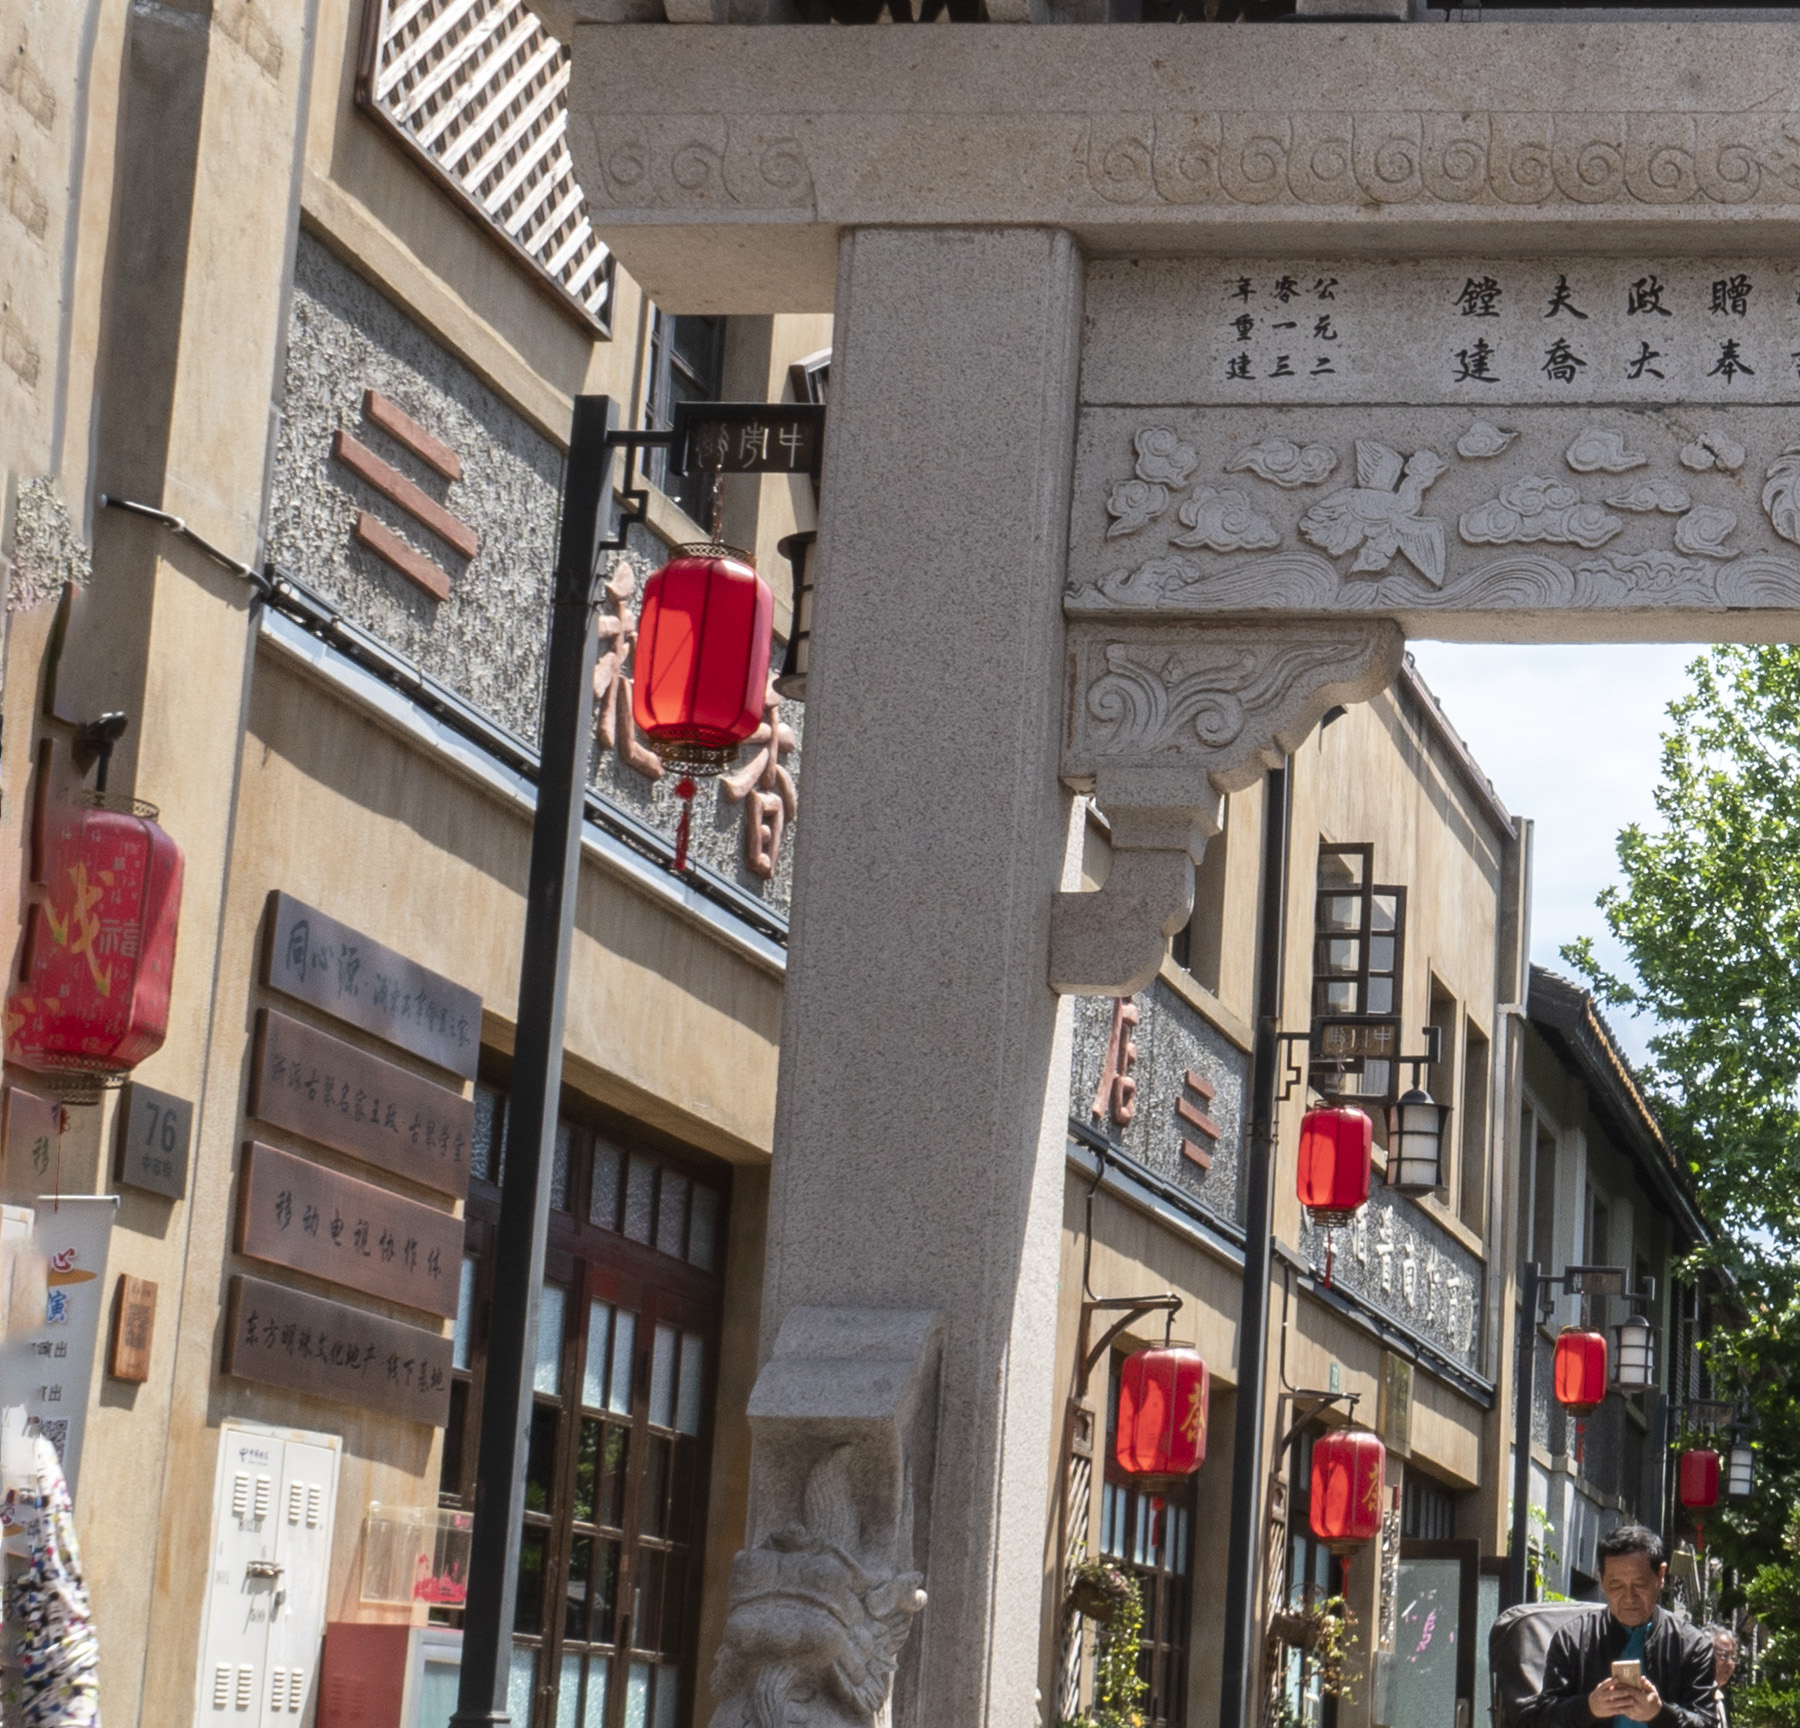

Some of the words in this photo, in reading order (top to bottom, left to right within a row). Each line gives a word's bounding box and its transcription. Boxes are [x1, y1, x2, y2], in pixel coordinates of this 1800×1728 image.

[1225, 275, 1257, 380] 年重建
[1267, 275, 1301, 378] 零一三
[1309, 277, 1340, 376] 公元二
[1453, 276, 1502, 384] 鏜建
[1541, 275, 1589, 384] 夫喬
[1626, 275, 1673, 381] 政大
[1707, 274, 1755, 384] 贈奉
[145, 1101, 178, 1153] 76
